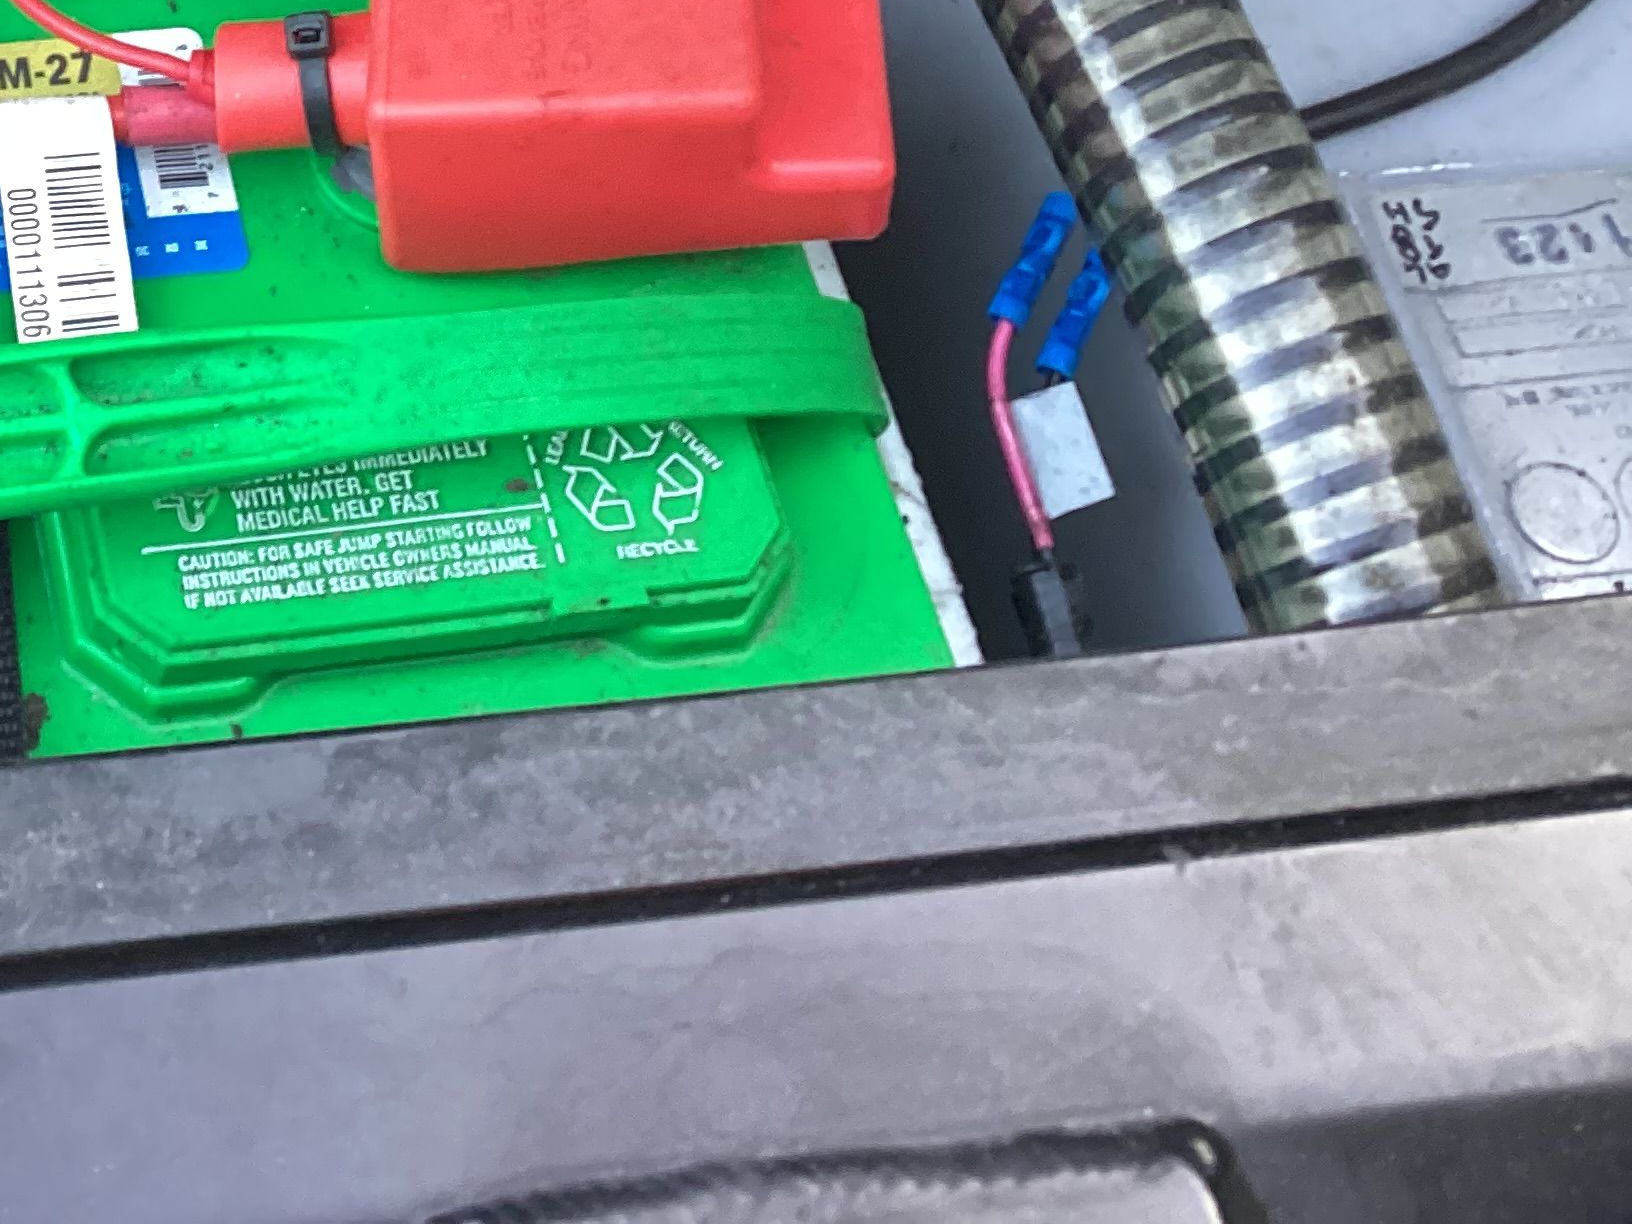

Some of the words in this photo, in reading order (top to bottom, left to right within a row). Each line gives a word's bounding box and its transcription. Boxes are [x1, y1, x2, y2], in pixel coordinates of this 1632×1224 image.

[6, 188, 52, 338] 0000111306
[231, 486, 286, 510] WITH
[375, 469, 415, 494] GET
[235, 505, 331, 534] MEDICAL
[332, 496, 385, 522] HELP
[389, 488, 441, 515] FAST
[177, 550, 256, 573] CAUTION:
[258, 544, 291, 563] FOR
[293, 538, 336, 560] SAFE
[338, 533, 382, 554] JUMP
[384, 523, 465, 549] STARTING
[466, 516, 532, 538] FOLLOW
[616, 538, 700, 560] RECYCLE
[182, 562, 301, 591] INSTRUCTIONS
[303, 560, 322, 577] IN
[323, 551, 391, 575] VEHICLE
[183, 593, 200, 610] IF
[204, 589, 237, 608] NOT
[240, 578, 326, 604] AVAILABLE
[328, 572, 371, 594] SEEK
[372, 564, 440, 589] SERVICE
